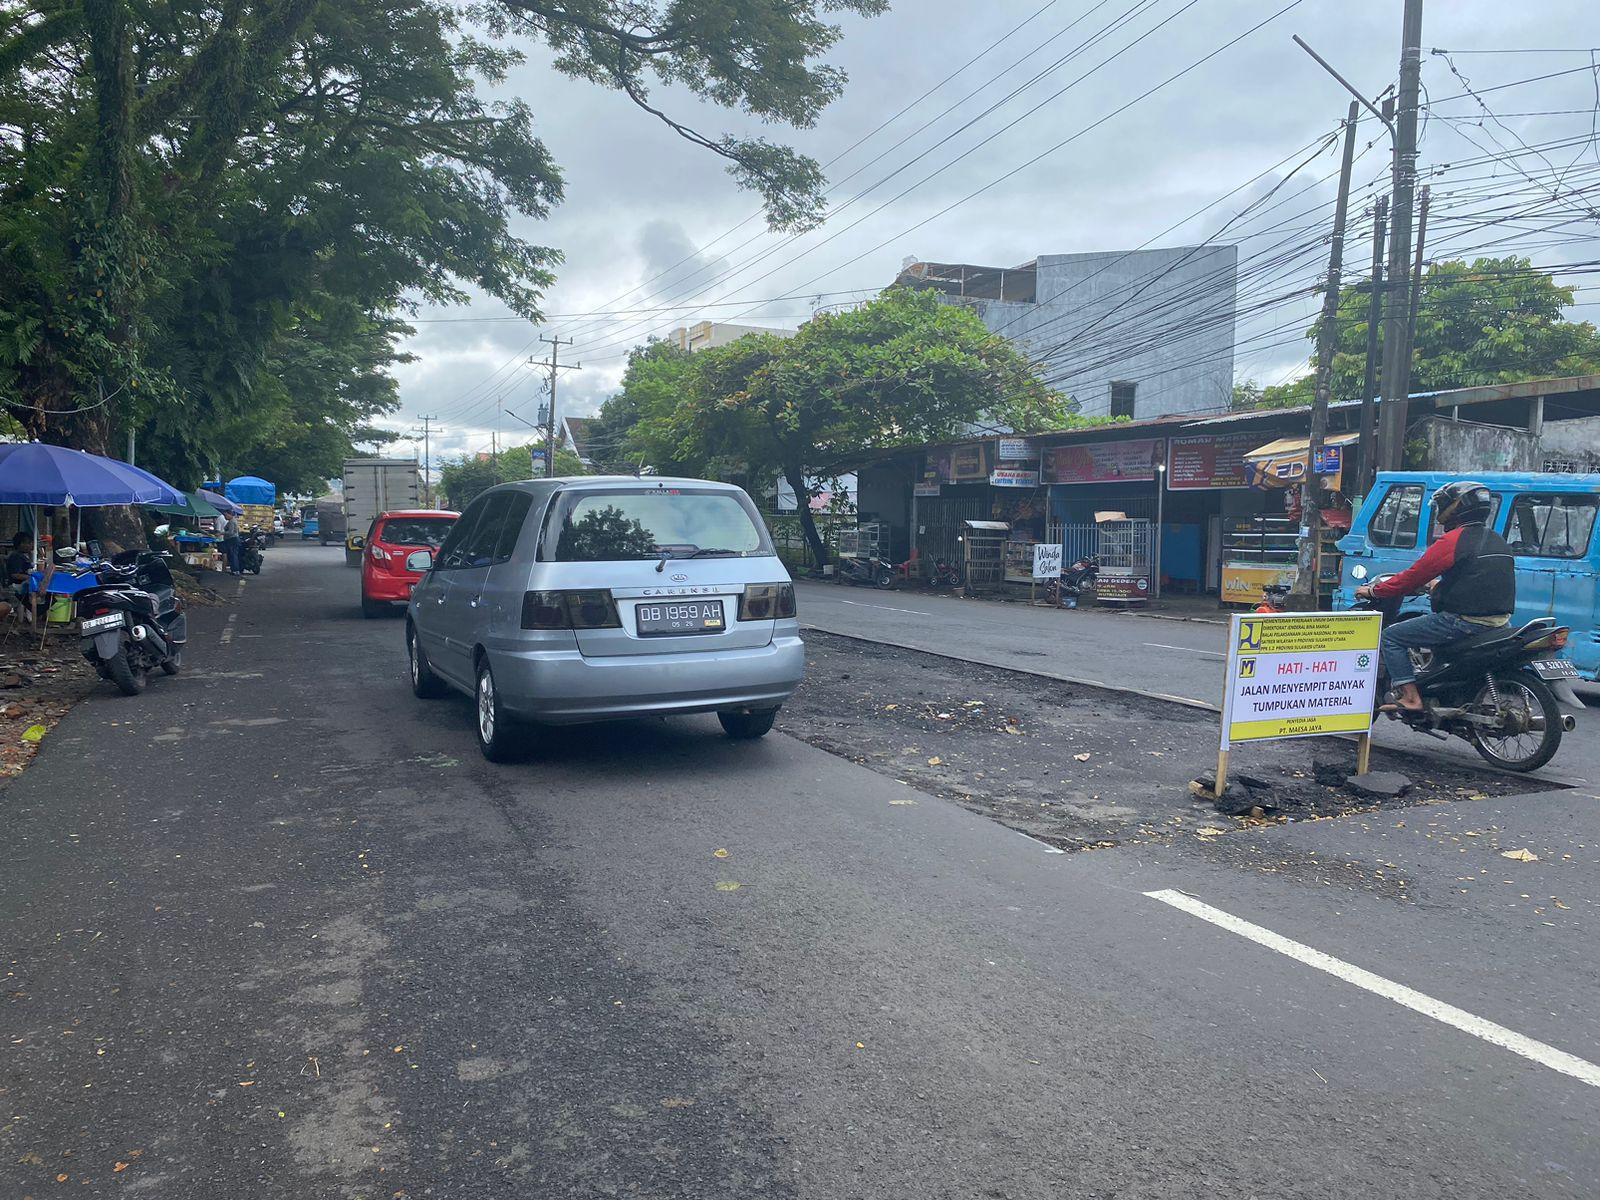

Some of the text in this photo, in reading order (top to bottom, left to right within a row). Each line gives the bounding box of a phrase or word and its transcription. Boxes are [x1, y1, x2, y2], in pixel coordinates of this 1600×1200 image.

[1038, 546, 1060, 560] Winda
[640, 605, 721, 621] DB 1959 AH
[1278, 662, 1303, 674] HATI
[1312, 661, 1337, 672] HATI
[1240, 680, 1365, 697] JALAN MENYEMPIT BANYAK
[1253, 697, 1352, 712] TUMPUKAN MATERIAL
